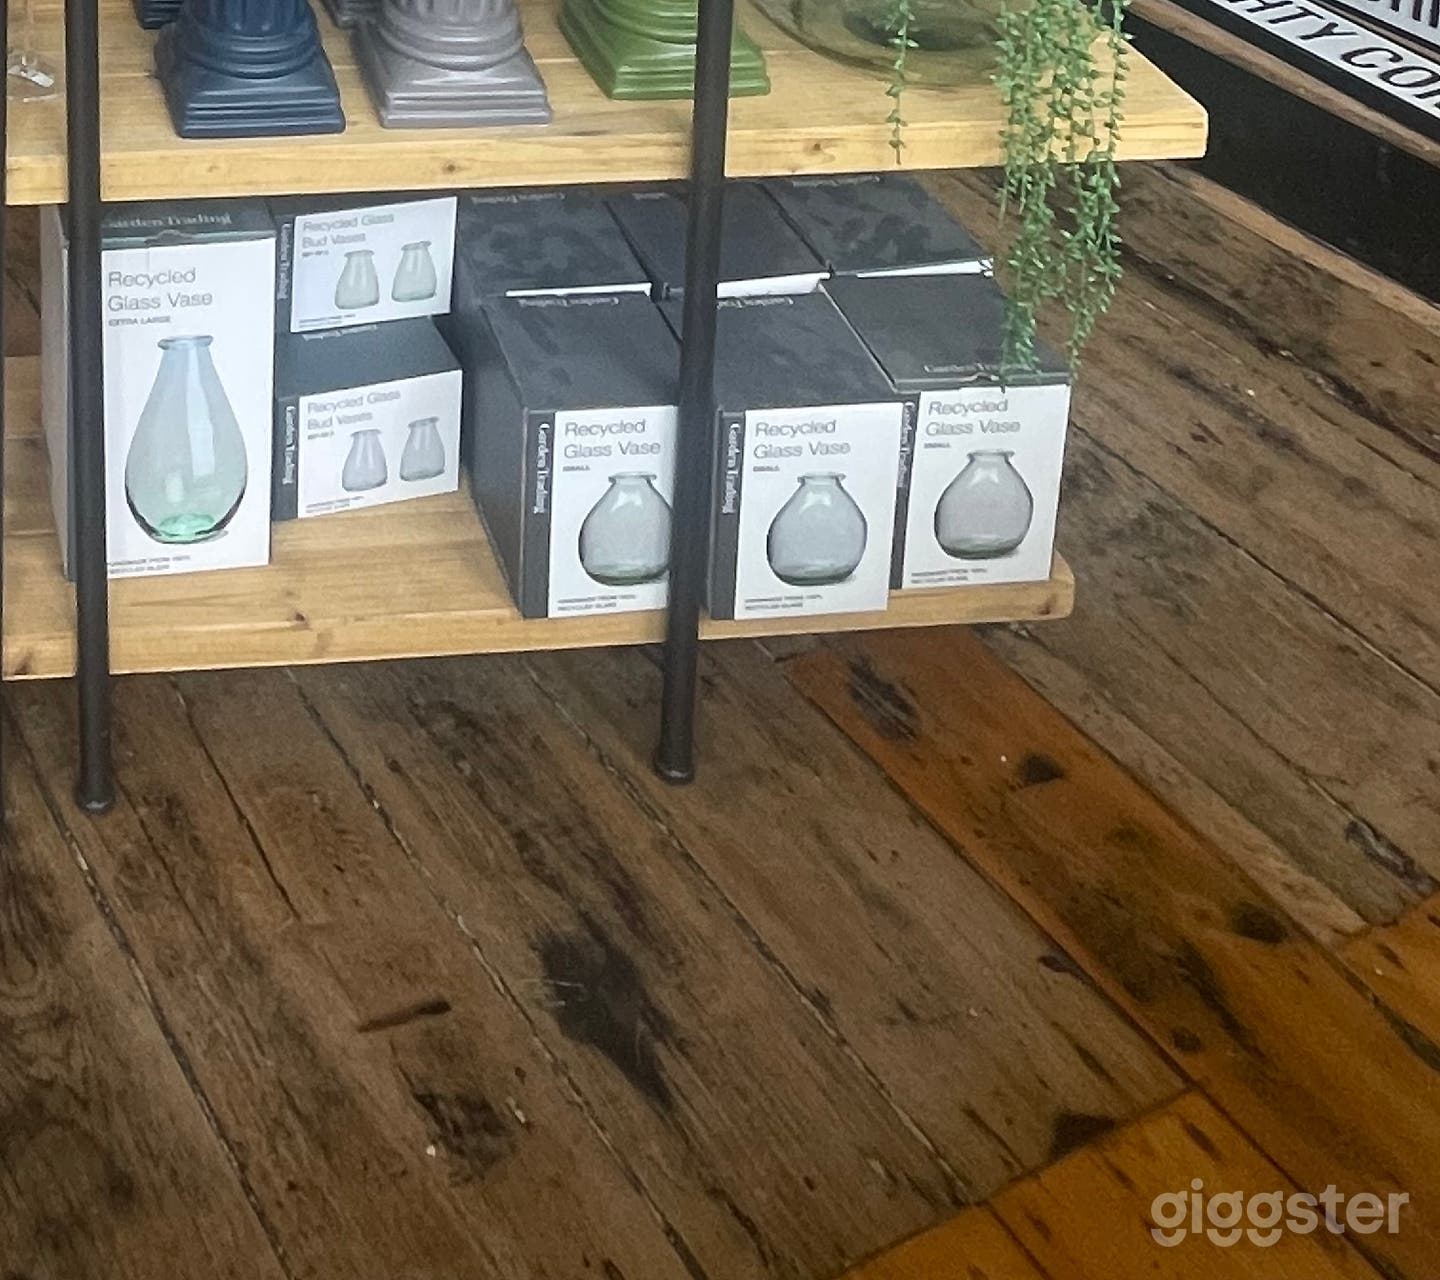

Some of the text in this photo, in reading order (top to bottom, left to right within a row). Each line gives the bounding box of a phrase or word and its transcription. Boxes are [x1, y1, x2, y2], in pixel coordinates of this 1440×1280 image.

[302, 213, 395, 233] Recycled Glass
[302, 235, 328, 249] Bud
[108, 267, 197, 289] Recycled
[107, 291, 214, 312] Glass Vase
[307, 390, 402, 413] Recycled Glass
[928, 399, 1009, 417] Recycled
[307, 416, 333, 430] Bud
[564, 419, 646, 438] Recycled
[754, 419, 837, 438] Recycled
[925, 419, 1021, 437] Glass Vase
[563, 441, 661, 459] Glass Vase
[753, 441, 852, 459] Glass Vase
